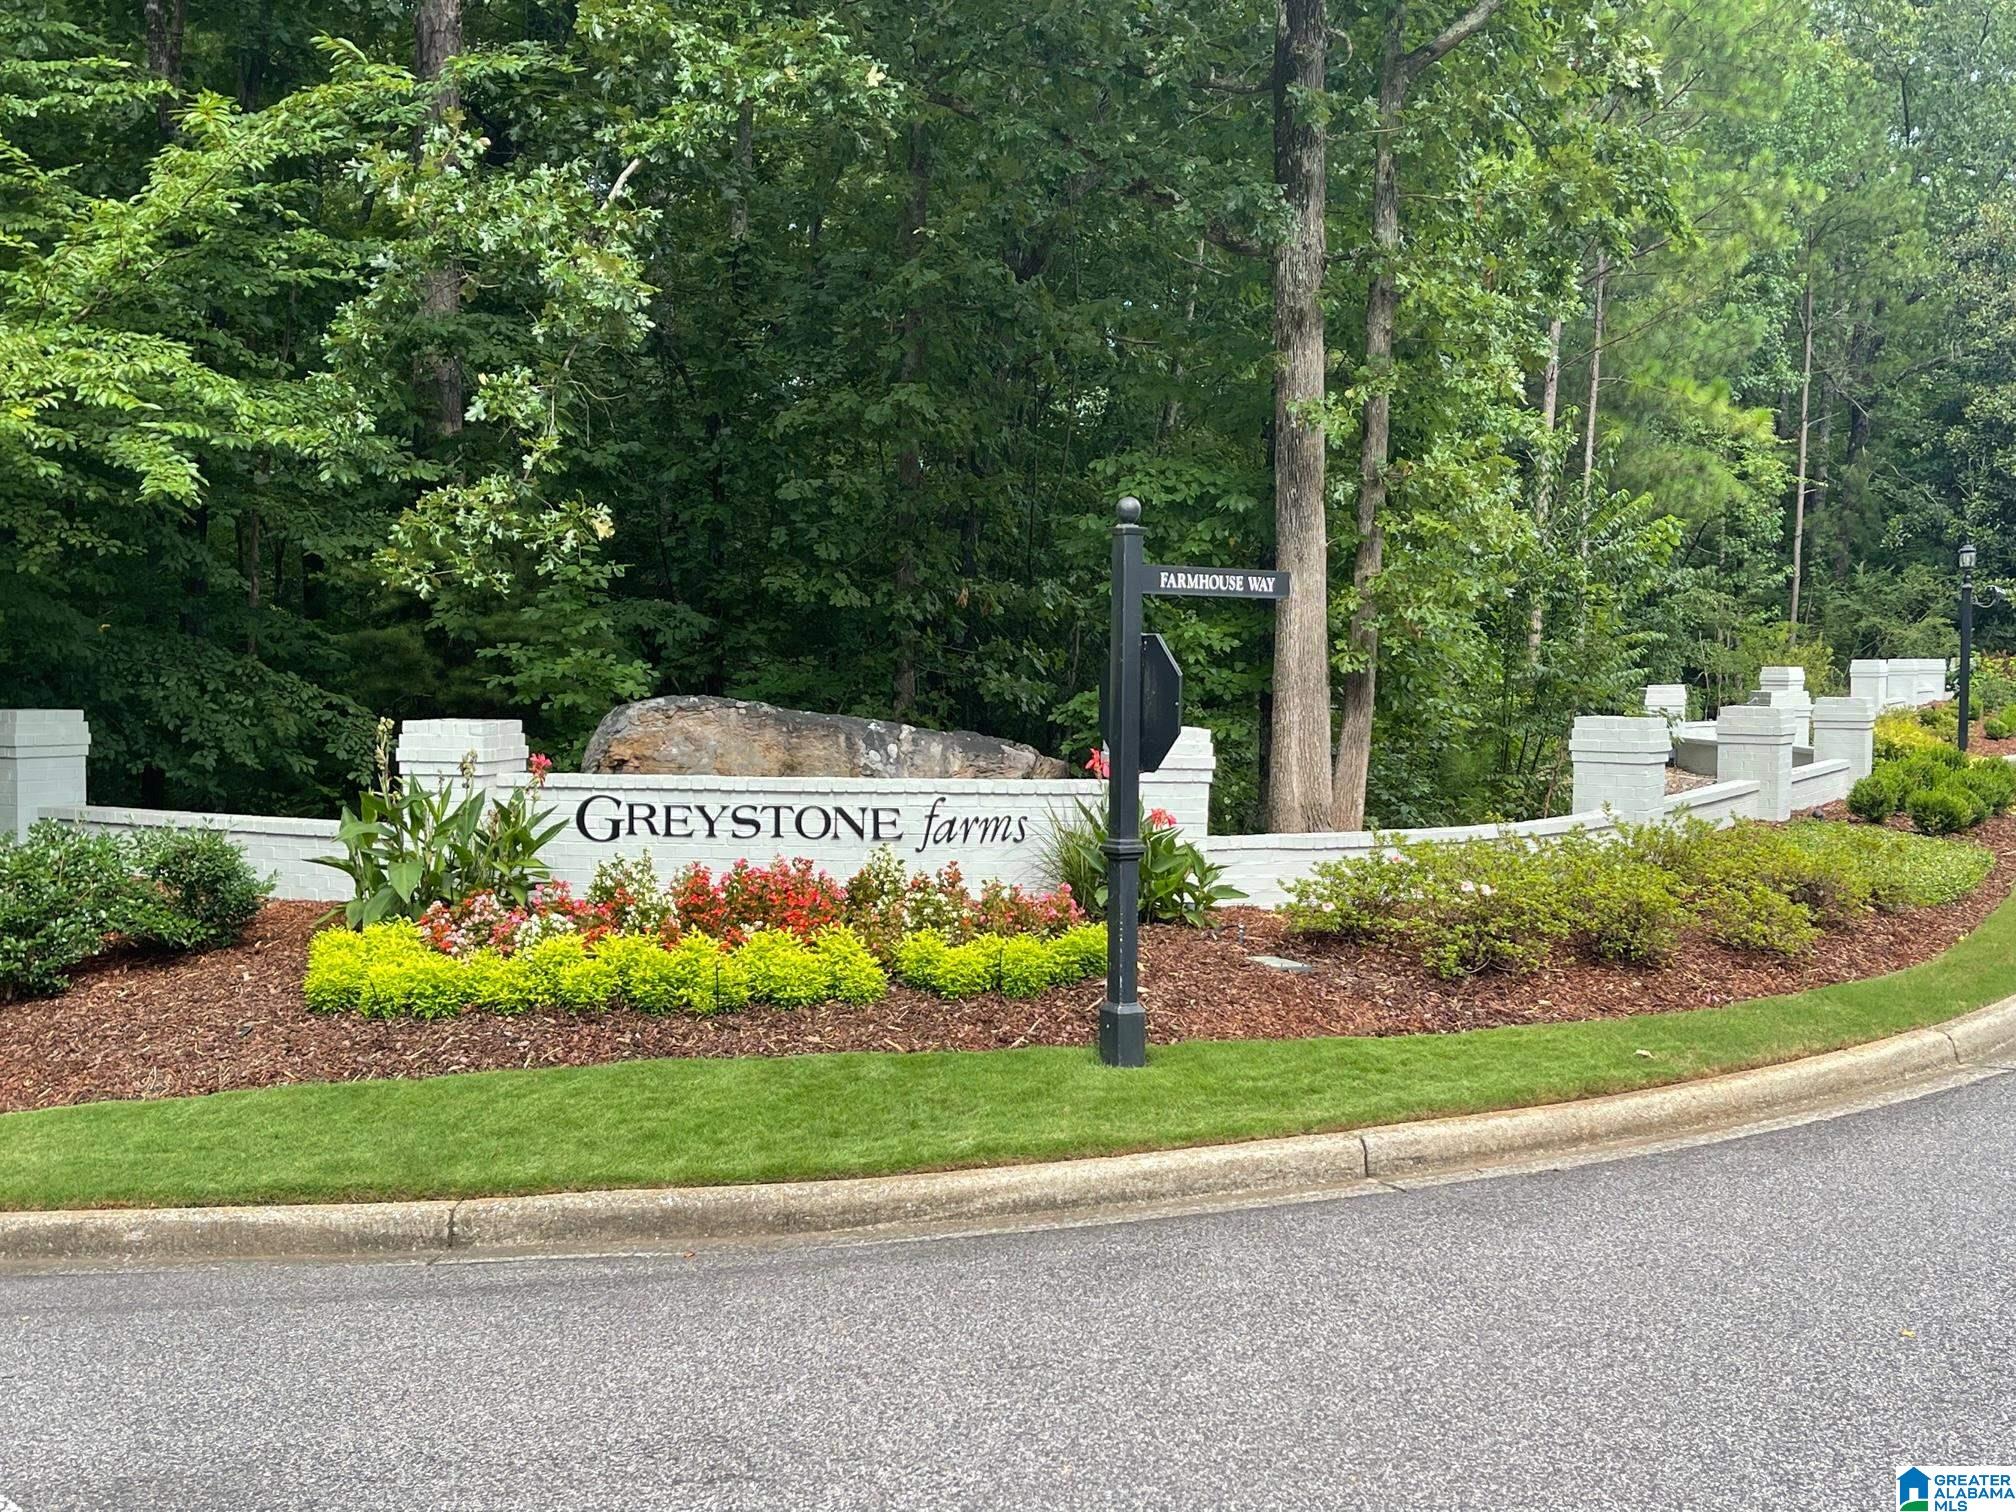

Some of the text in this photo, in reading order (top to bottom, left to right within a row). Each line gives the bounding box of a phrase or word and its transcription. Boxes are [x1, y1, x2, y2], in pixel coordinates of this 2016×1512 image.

[1159, 571, 1276, 593] FARMHOUSE WAY
[575, 794, 1029, 854] GREYSTONE farms
